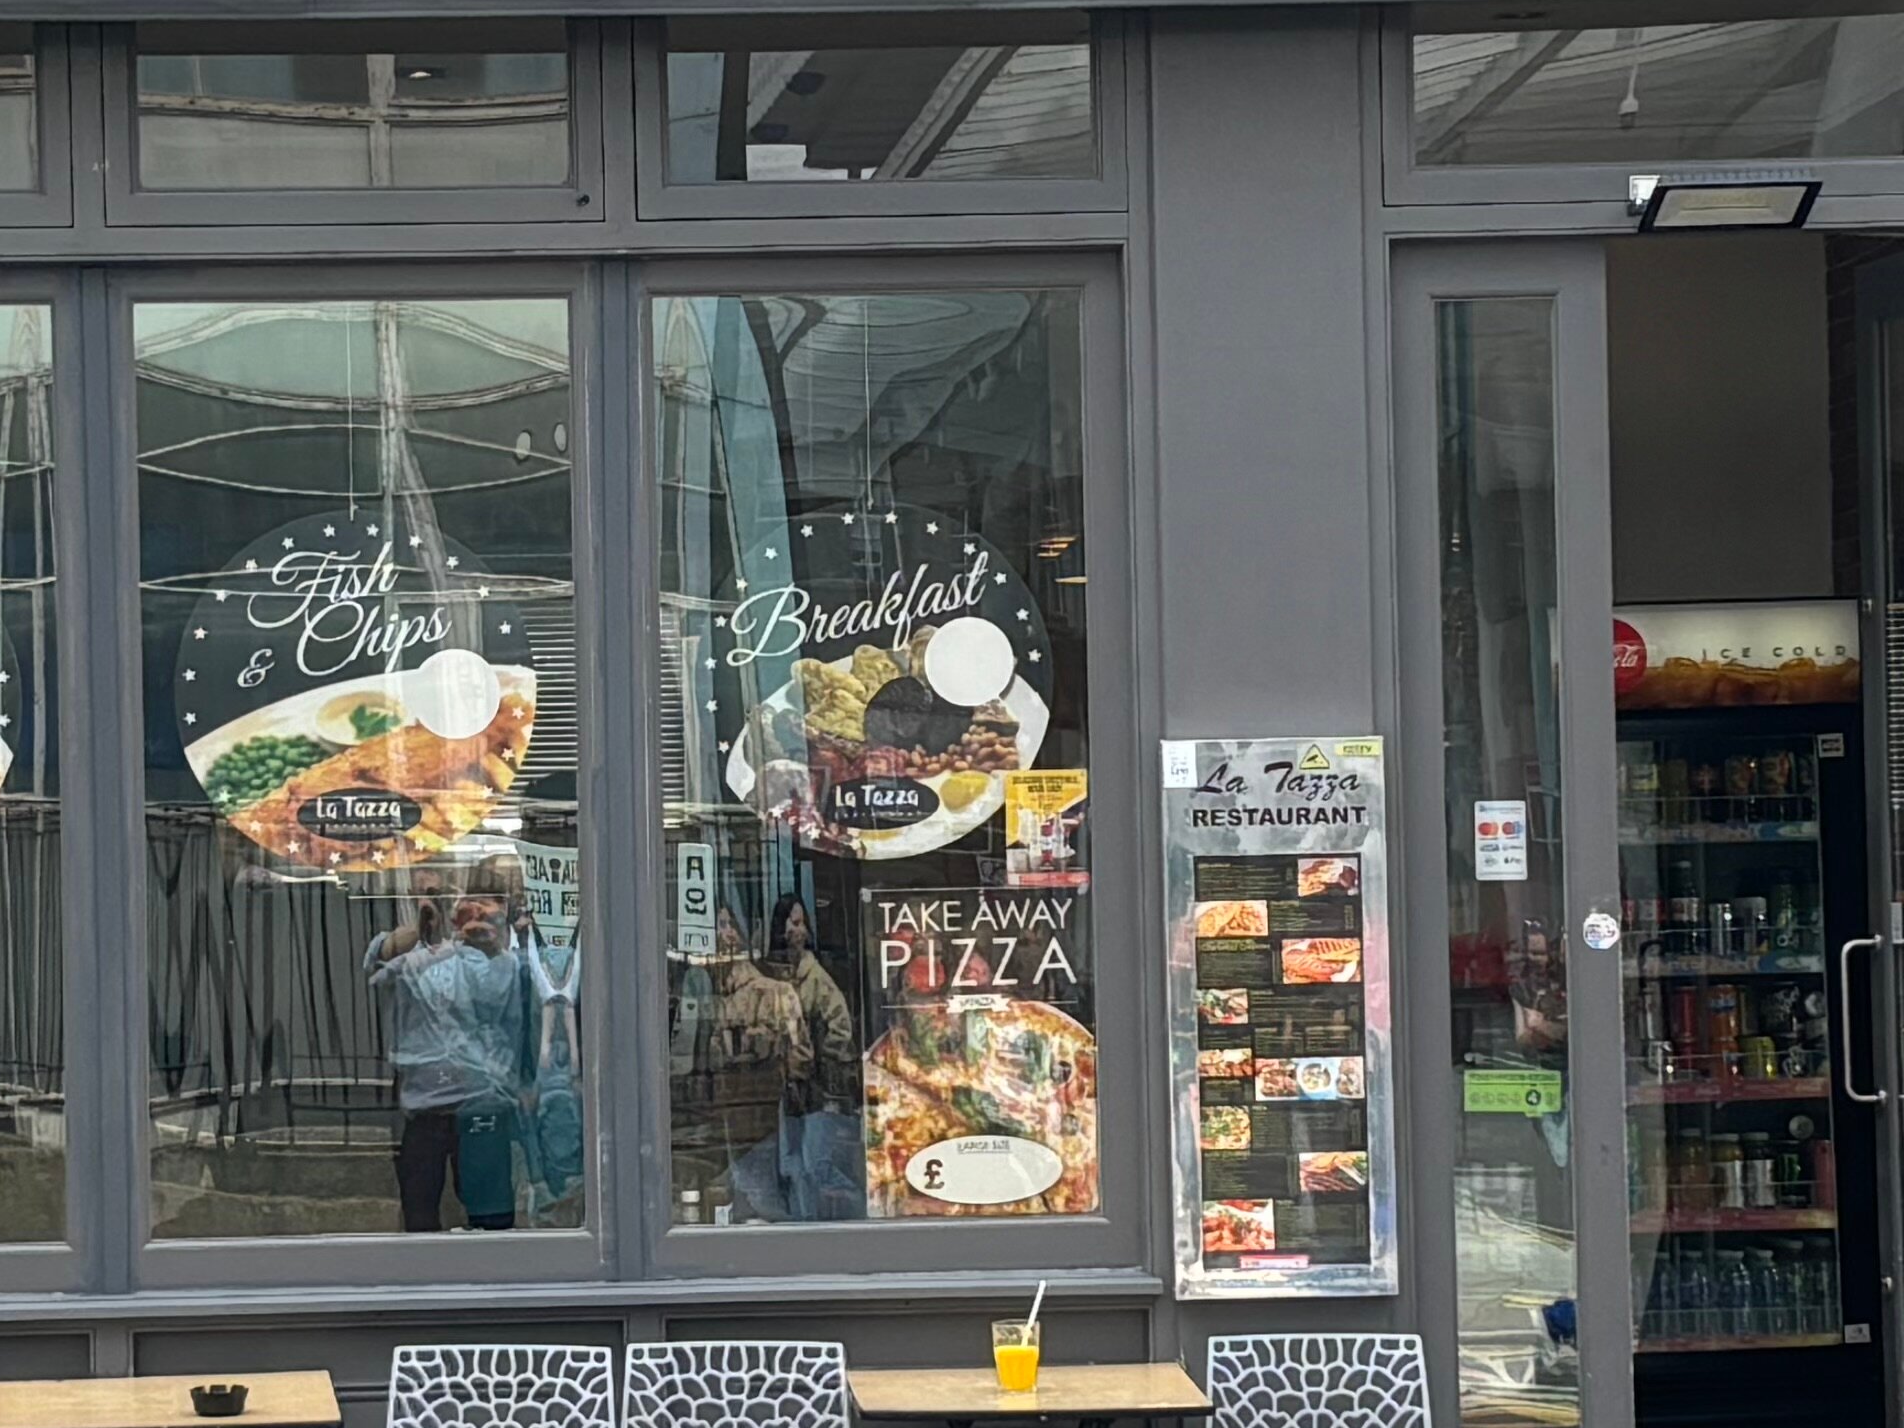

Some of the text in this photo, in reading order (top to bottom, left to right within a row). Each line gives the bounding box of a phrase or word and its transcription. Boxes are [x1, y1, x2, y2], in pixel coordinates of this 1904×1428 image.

[248, 541, 399, 629] Fish
[726, 550, 988, 667] Breakfast
[237, 601, 453, 688] & Chips
[1702, 645, 1846, 661] ICE COLD
[835, 785, 919, 807] La Tazza
[1196, 762, 1247, 794] La
[1264, 761, 1361, 801] Tazza
[316, 796, 401, 819] La Tazza
[1193, 806, 1367, 827] RESTAURANT
[878, 898, 1073, 933] TAKE AWAY
[880, 936, 1077, 989] PIZZA
[924, 1159, 945, 1189] £
